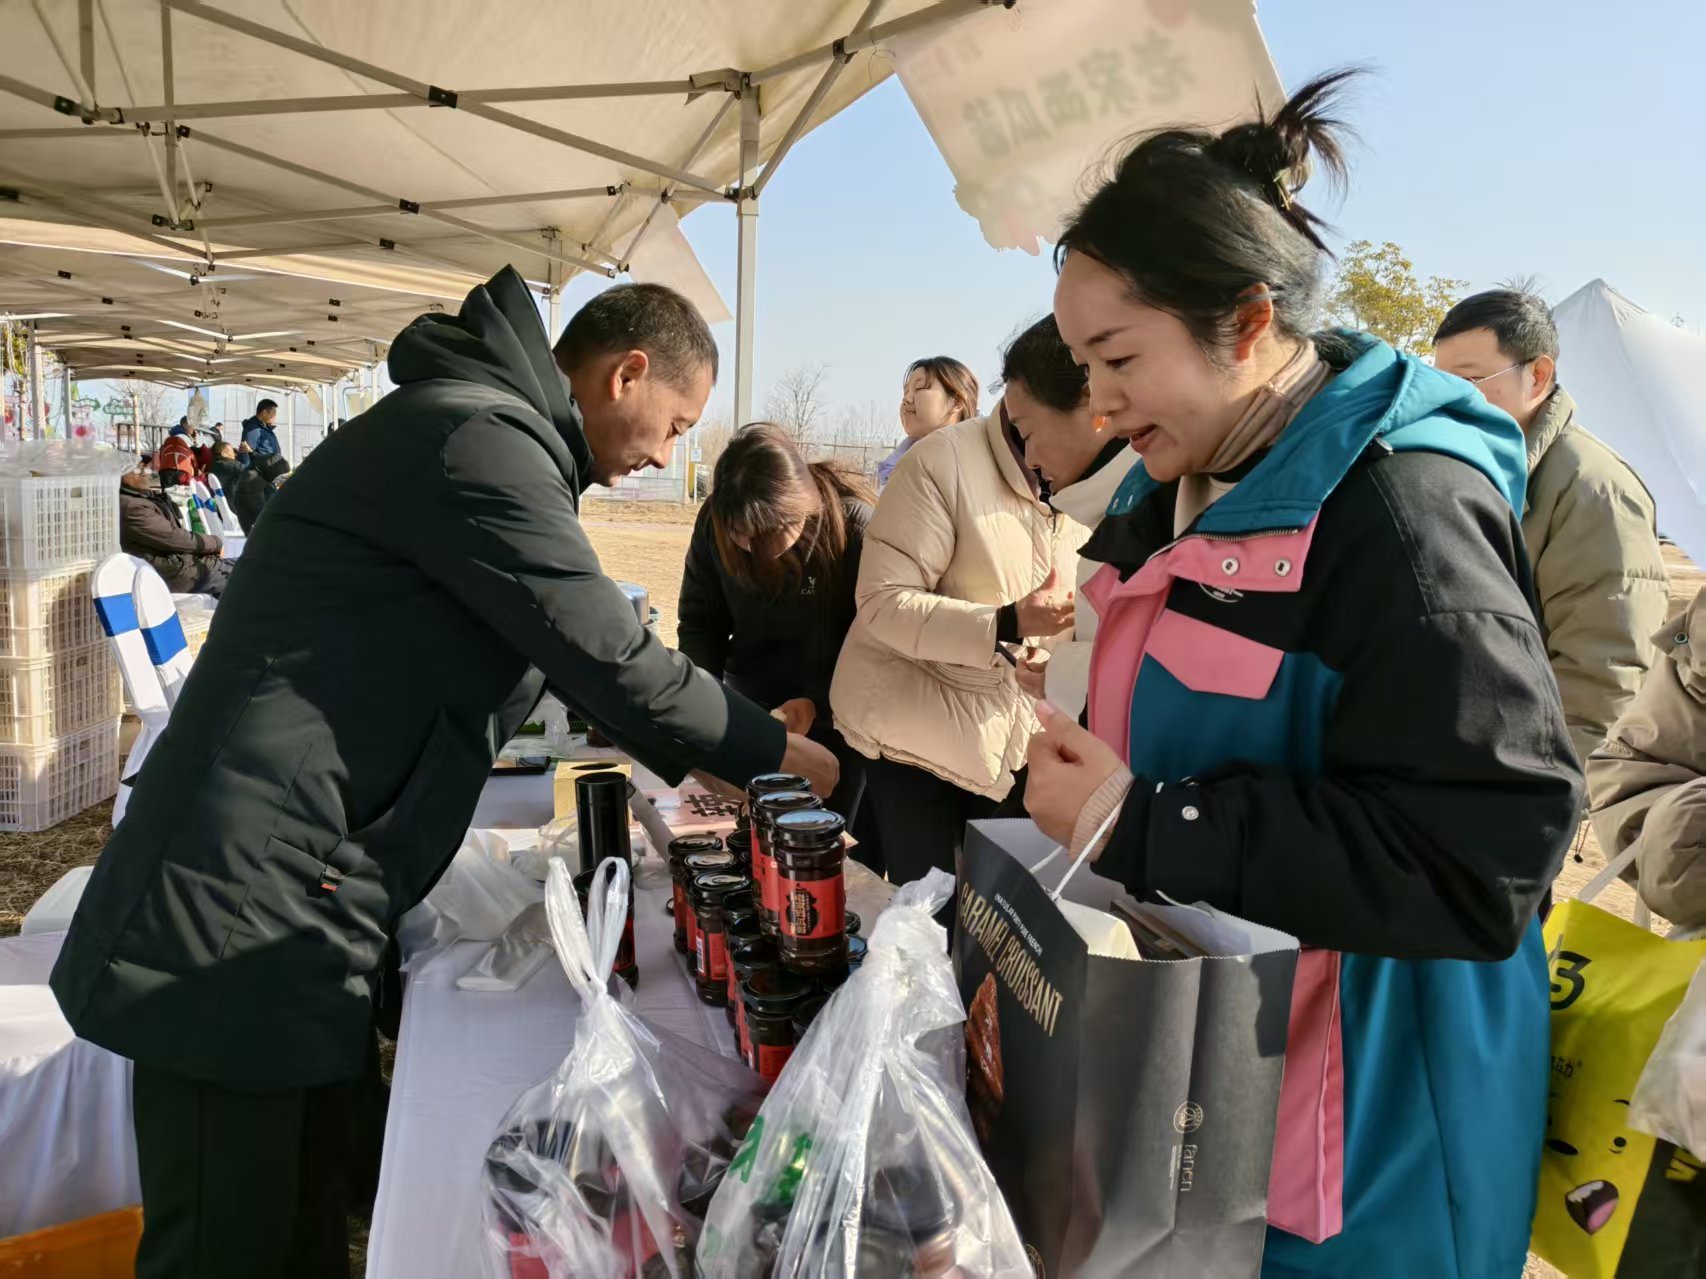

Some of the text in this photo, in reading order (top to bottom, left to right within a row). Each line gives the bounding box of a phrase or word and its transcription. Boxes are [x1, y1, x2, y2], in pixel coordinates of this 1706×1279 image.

[960, 881, 1063, 1038] CARAMEL CROISSANT
[1180, 1143, 1199, 1193] fanen
